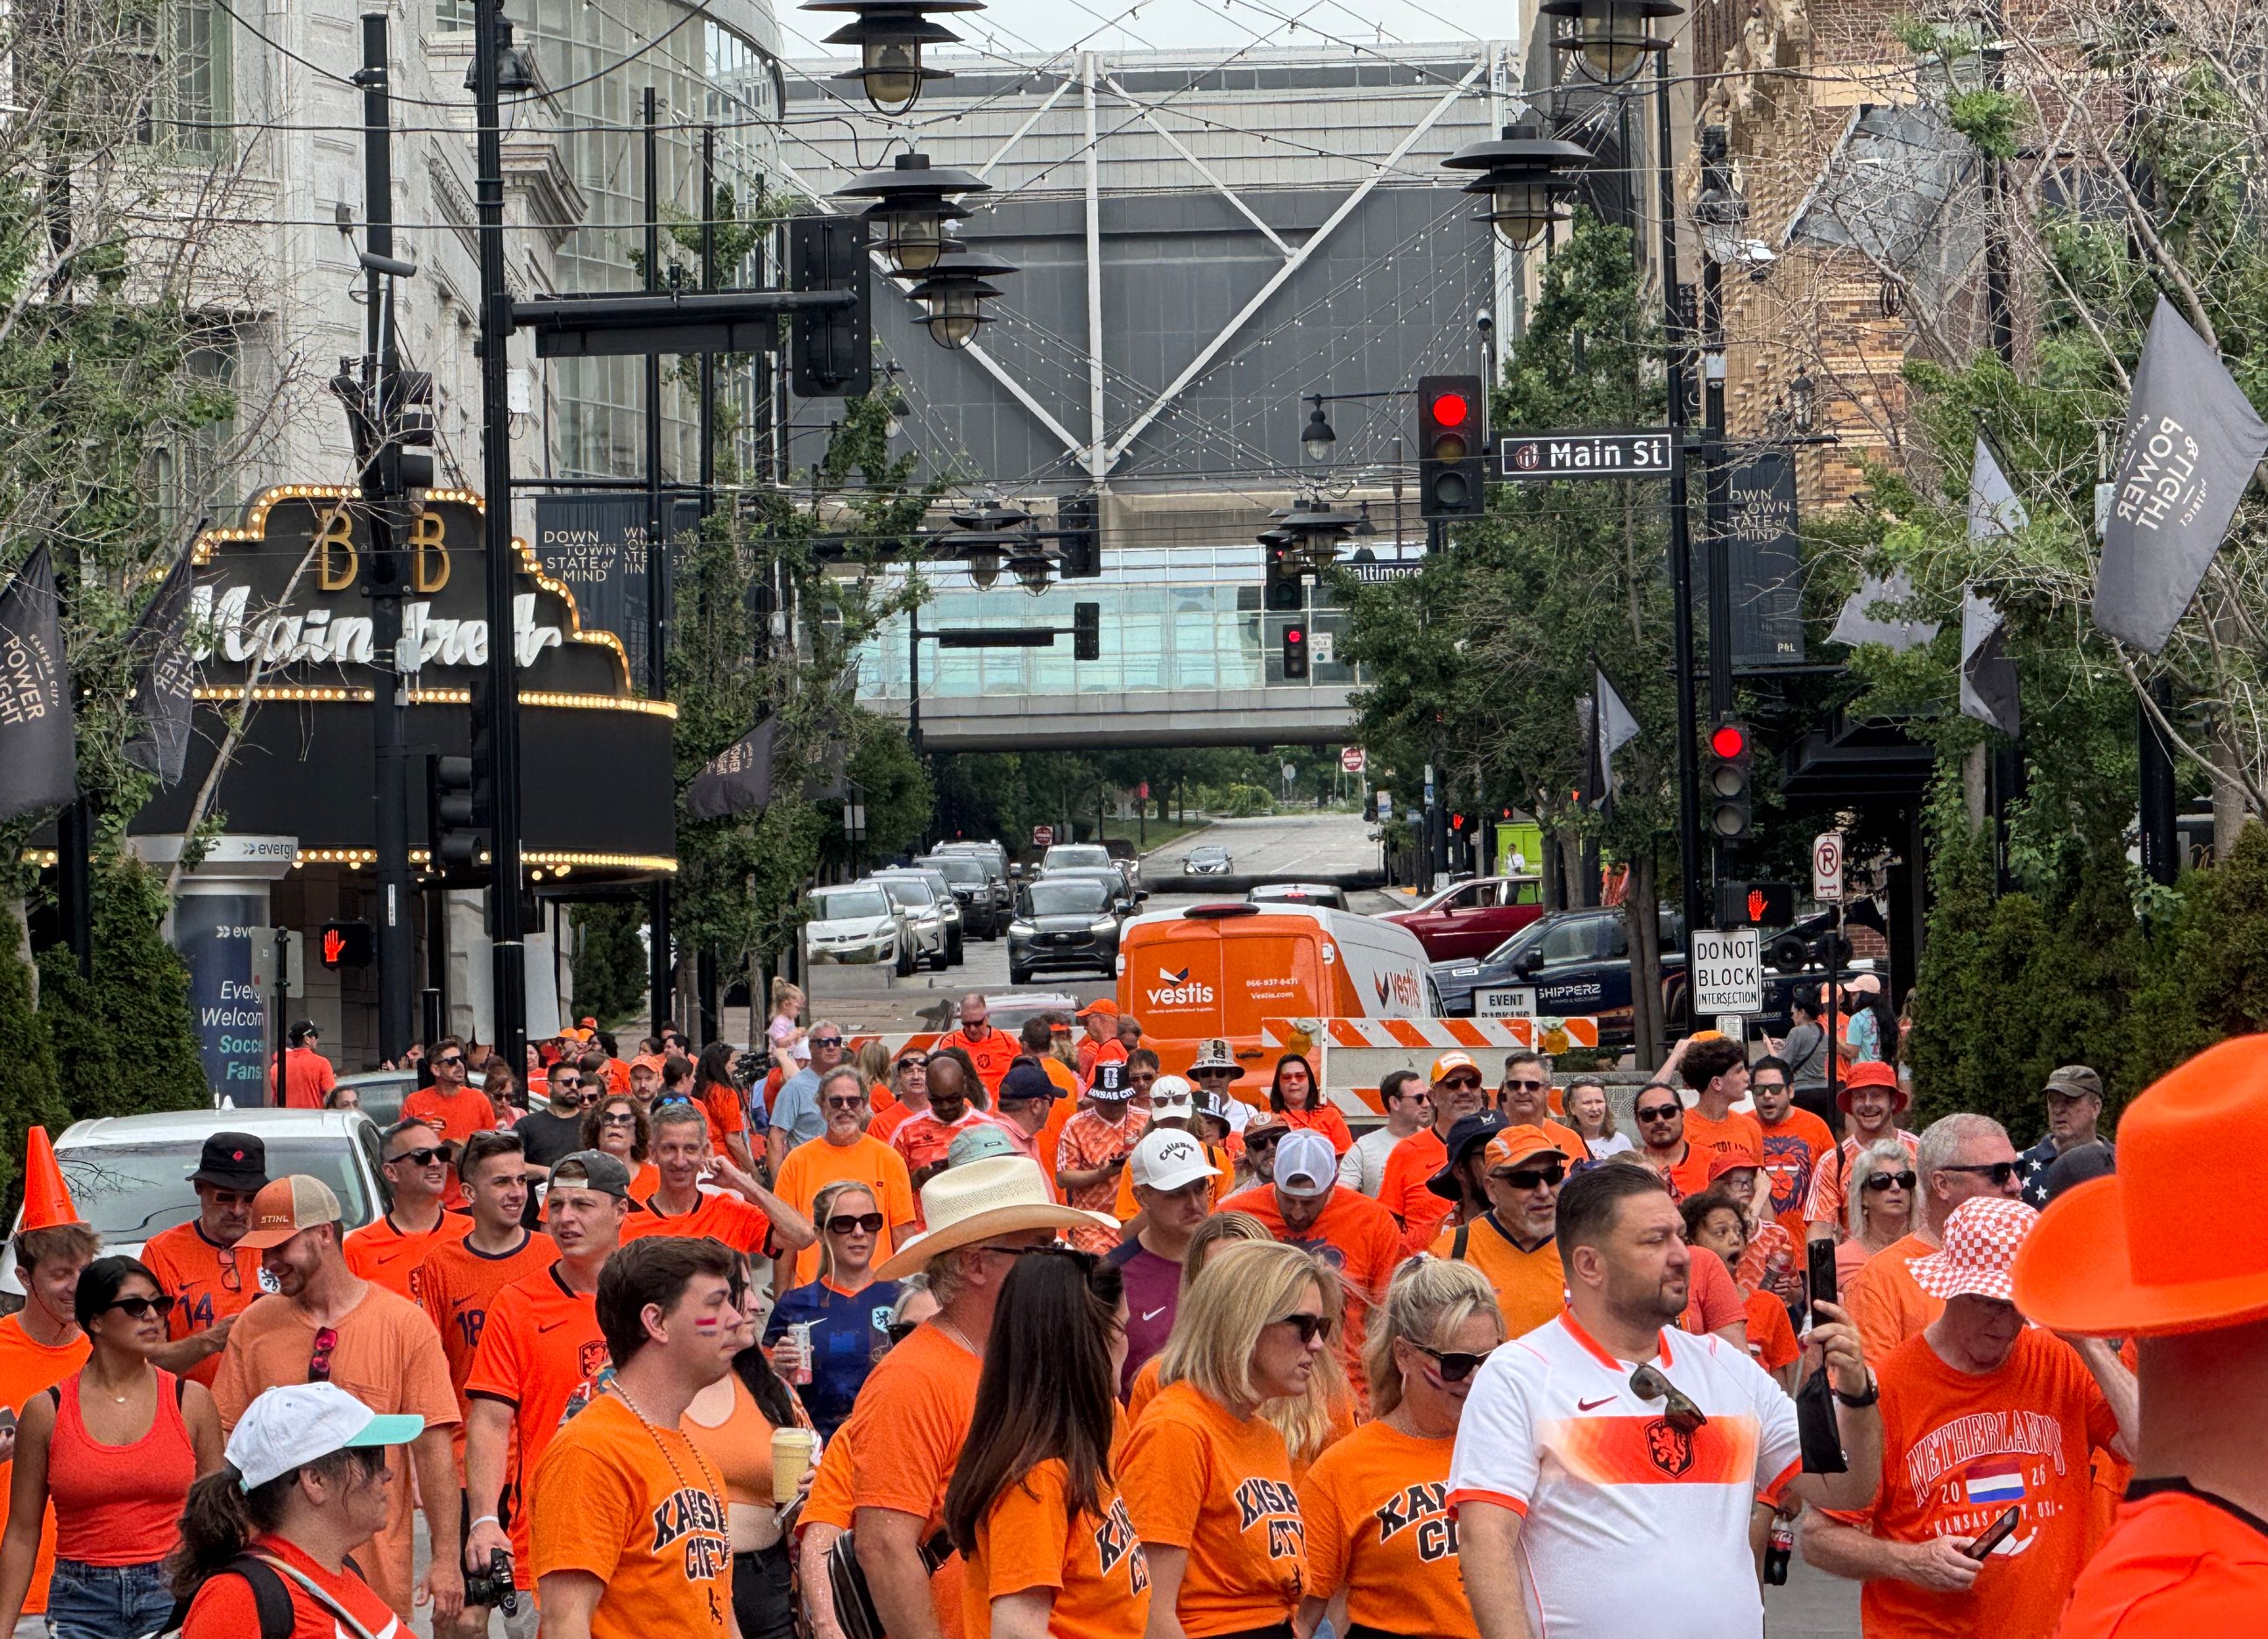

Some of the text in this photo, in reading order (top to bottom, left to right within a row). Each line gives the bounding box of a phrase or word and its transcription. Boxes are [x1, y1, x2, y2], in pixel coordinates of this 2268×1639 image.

[1550, 439, 1662, 467] Main St
[544, 530, 599, 543] DOWN
[564, 543, 616, 557] TOWN
[547, 557, 599, 569] STATE
[601, 558, 613, 569] of
[563, 570, 606, 582] MIND
[4, 635, 46, 720] POWER
[233, 926, 252, 938] eve
[1697, 941, 1754, 960] DO NOT
[1698, 968, 1755, 986] BLOCK
[1146, 983, 1214, 1005] vestis
[1489, 994, 1523, 1006] EVENT
[1538, 983, 1601, 999] SHIPPERZ
[1698, 991, 1756, 1005] INTERSECTION
[202, 1007, 264, 1027] Welcom
[219, 1035, 263, 1054] Socce
[261, 1215, 289, 1224] STIHL
[177, 1292, 216, 1330] 14
[456, 1309, 485, 1349] 18
[1906, 1409, 2066, 1508] NETHERLANDS
[1940, 1464, 2046, 1505] 20 26
[1374, 1480, 1449, 1545] KAN
[1934, 1510, 1988, 1536] KANSAS
[1416, 1516, 1460, 1563] CI
